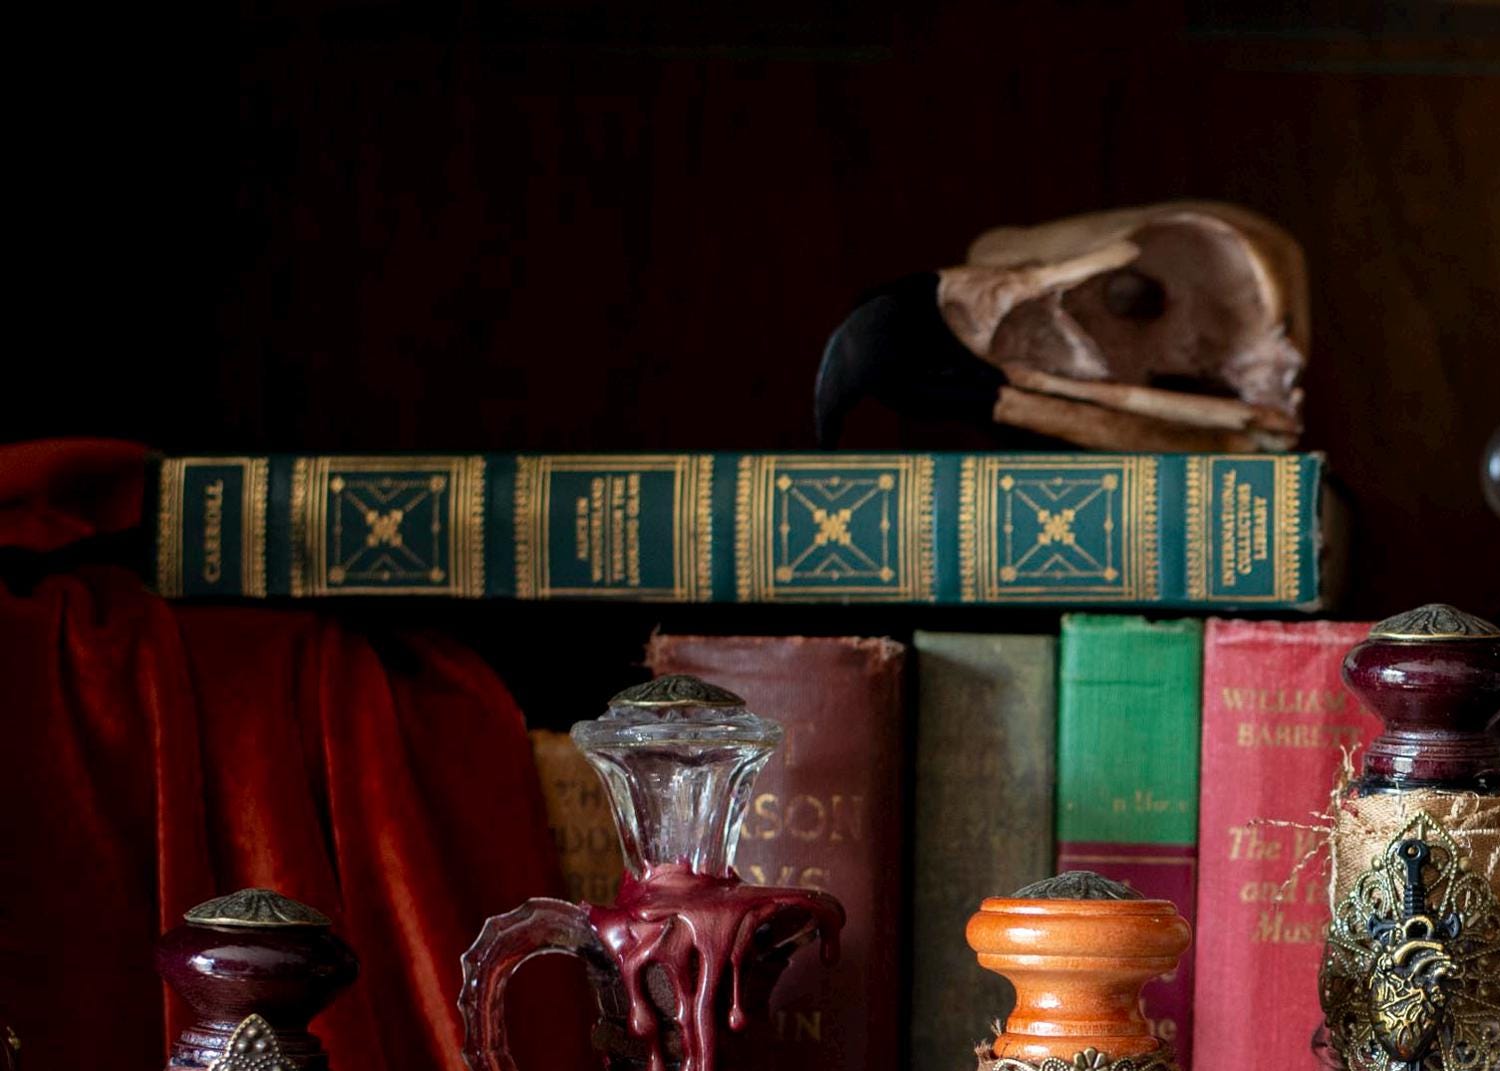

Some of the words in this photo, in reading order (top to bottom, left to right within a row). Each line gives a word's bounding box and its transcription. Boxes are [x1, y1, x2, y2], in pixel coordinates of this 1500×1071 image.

[1221, 469, 1237, 587] INTERNATIONAL
[1252, 496, 1268, 561] LIBRARY
[1222, 688, 1346, 714] WILLIAM
[1238, 723, 1362, 748] BARRETT
[1229, 825, 1281, 860] The
